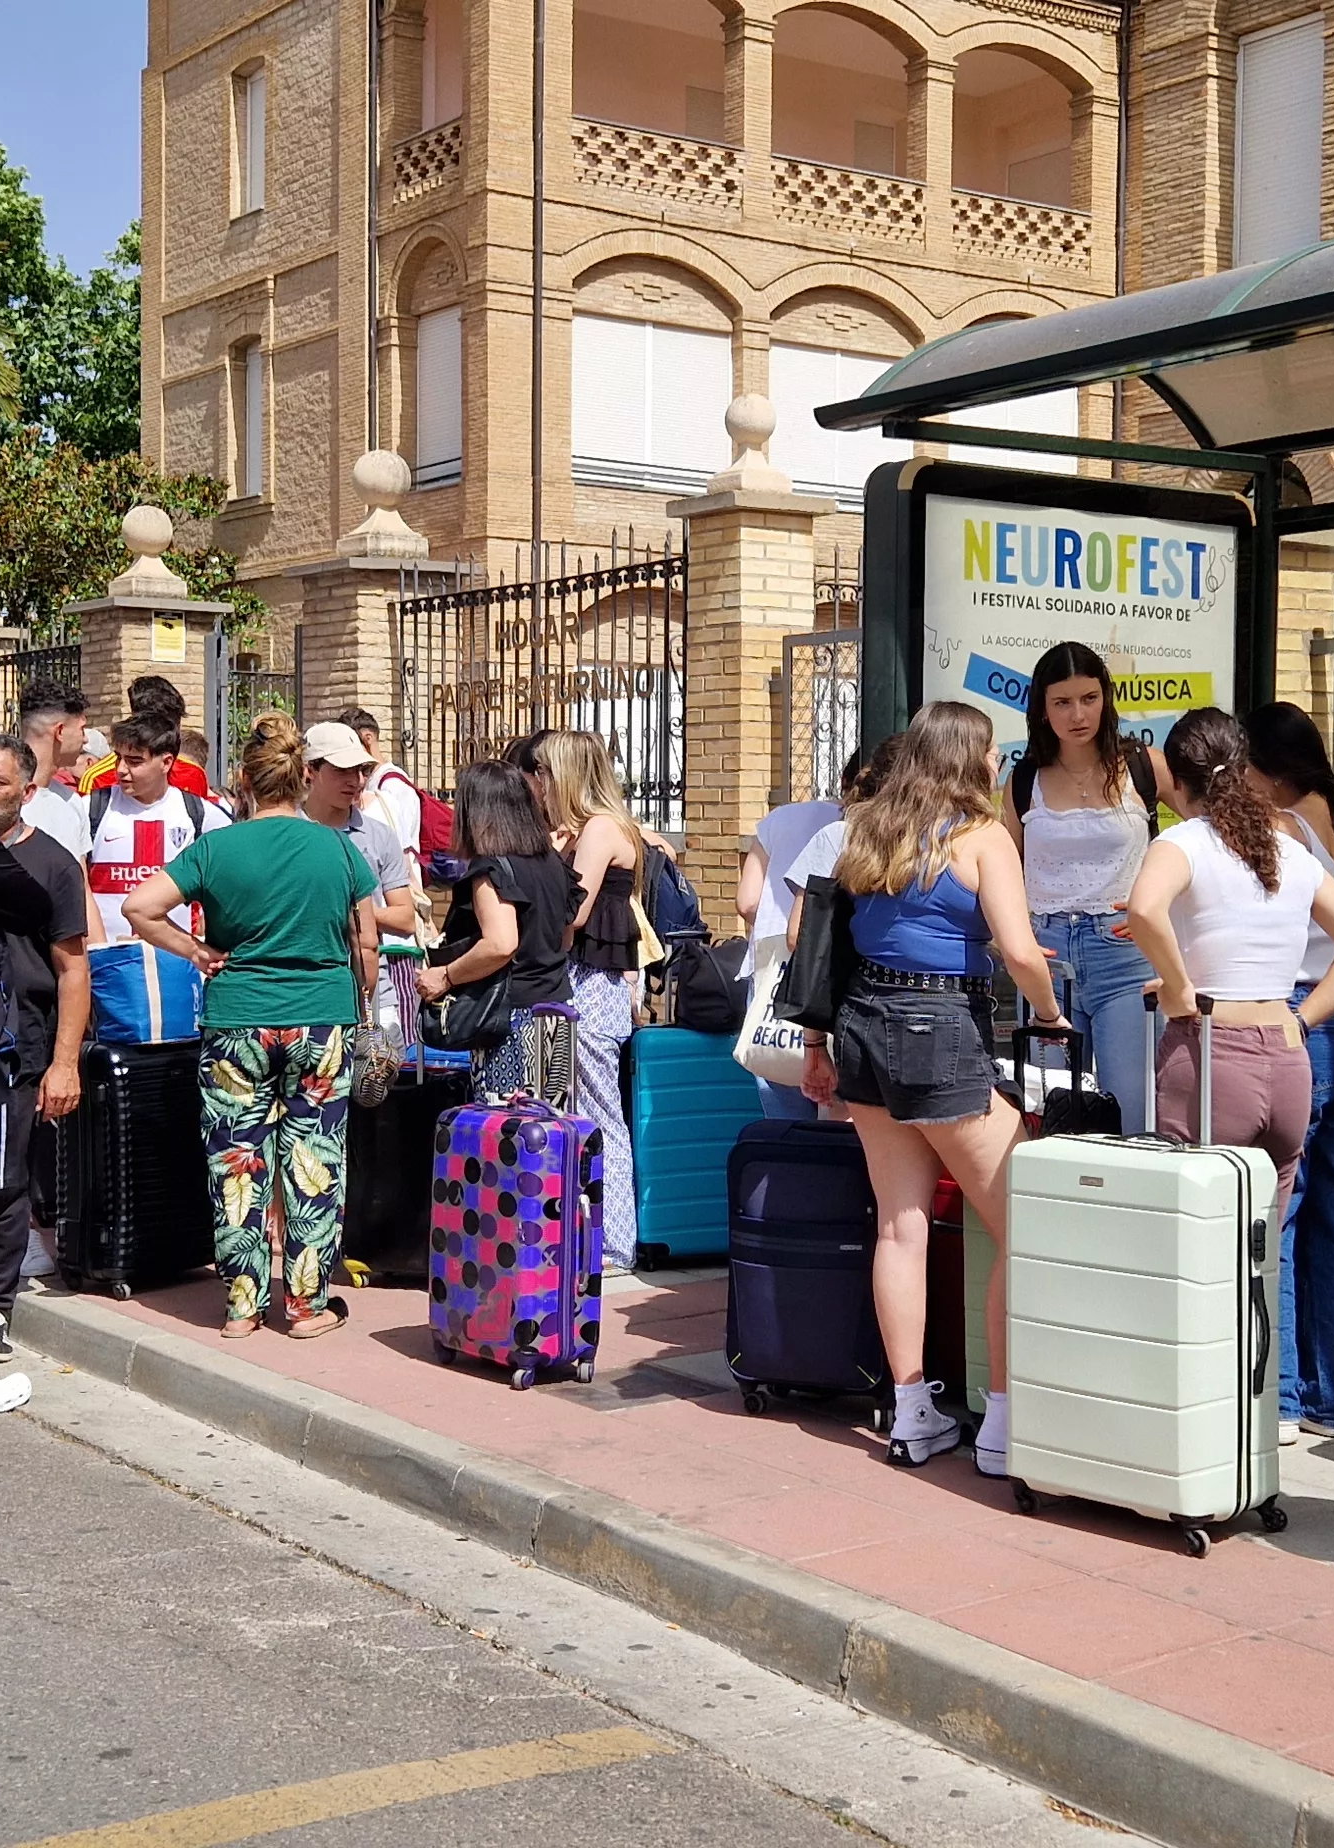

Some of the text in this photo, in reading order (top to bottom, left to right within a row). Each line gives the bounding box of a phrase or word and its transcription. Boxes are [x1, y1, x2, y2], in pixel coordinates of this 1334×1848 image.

[963, 518, 1207, 600] NEUROFEST
[973, 591, 1192, 622] I FESTIVAL SOLIDARIO A FAVOR DE
[495, 611, 578, 652] HOGAR
[982, 634, 993, 646] LA
[1123, 644, 1192, 659] NEUROLÓGICOS
[432, 663, 655, 715] PADRE SATURNINO
[1113, 673, 1192, 702] MÚSICA
[751, 1025, 804, 1049] BEACH
